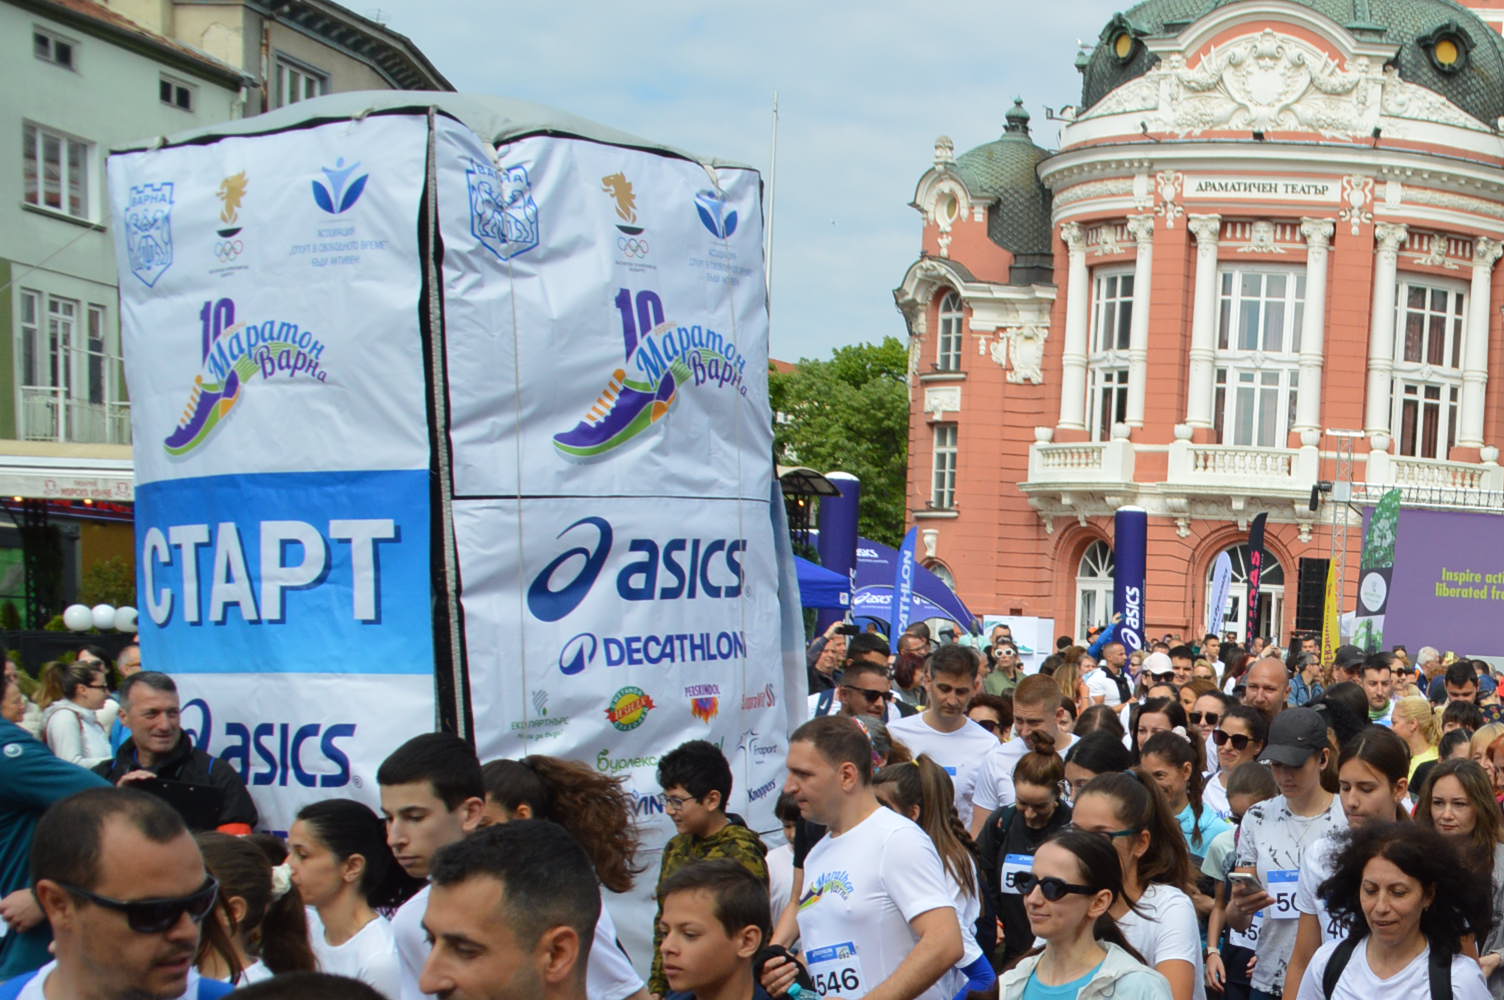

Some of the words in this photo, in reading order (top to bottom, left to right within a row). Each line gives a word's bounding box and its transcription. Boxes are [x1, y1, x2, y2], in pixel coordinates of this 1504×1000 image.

[1195, 180, 1278, 194] ДРАМАТИЧЕН
[1283, 183, 1330, 196] ТЕАТЪР
[200, 298, 236, 369] 10
[614, 288, 665, 364] 10
[208, 320, 325, 381] Маратон
[254, 345, 328, 383] Варна
[637, 325, 747, 387] Маратон
[687, 350, 747, 396] Варна
[143, 519, 401, 627] СТАРТ
[1435, 582, 1489, 600] liberated
[1442, 567, 1482, 585] Inspire
[603, 631, 748, 667] DECATHLON
